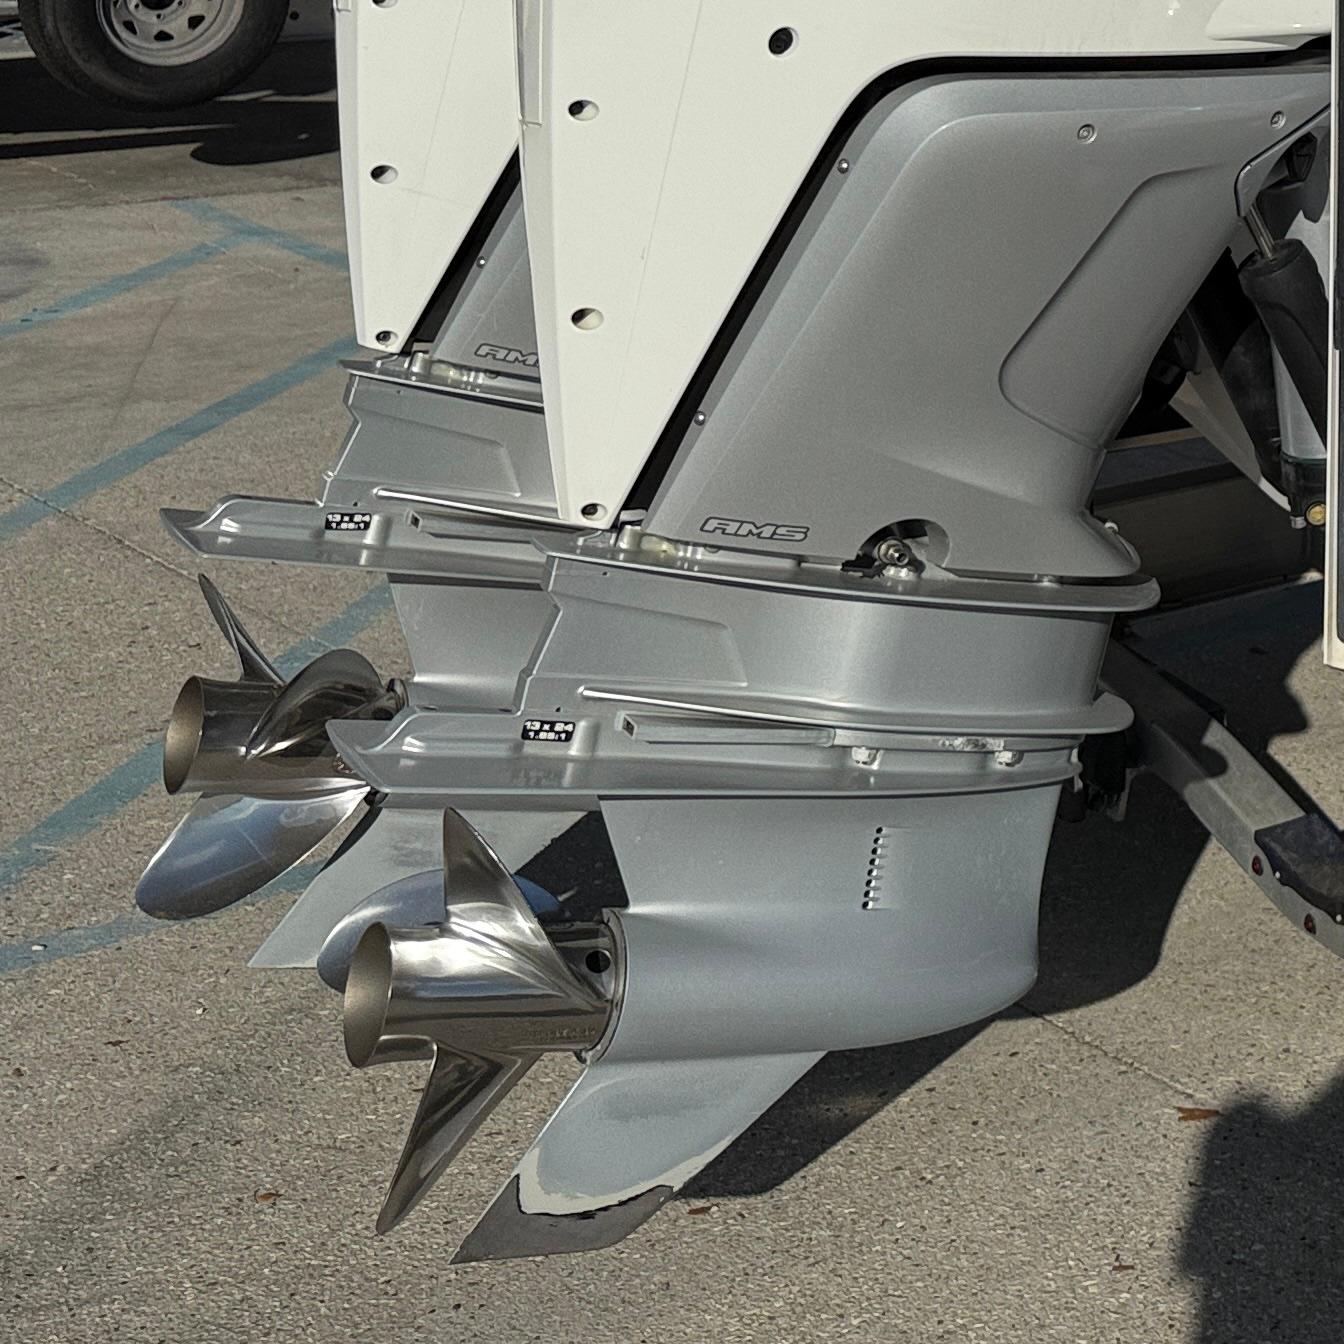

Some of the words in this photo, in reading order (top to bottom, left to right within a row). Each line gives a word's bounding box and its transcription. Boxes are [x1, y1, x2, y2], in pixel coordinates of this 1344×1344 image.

[474, 342, 539, 367] AM
[700, 516, 810, 543] AMS
[525, 720, 541, 731] 13
